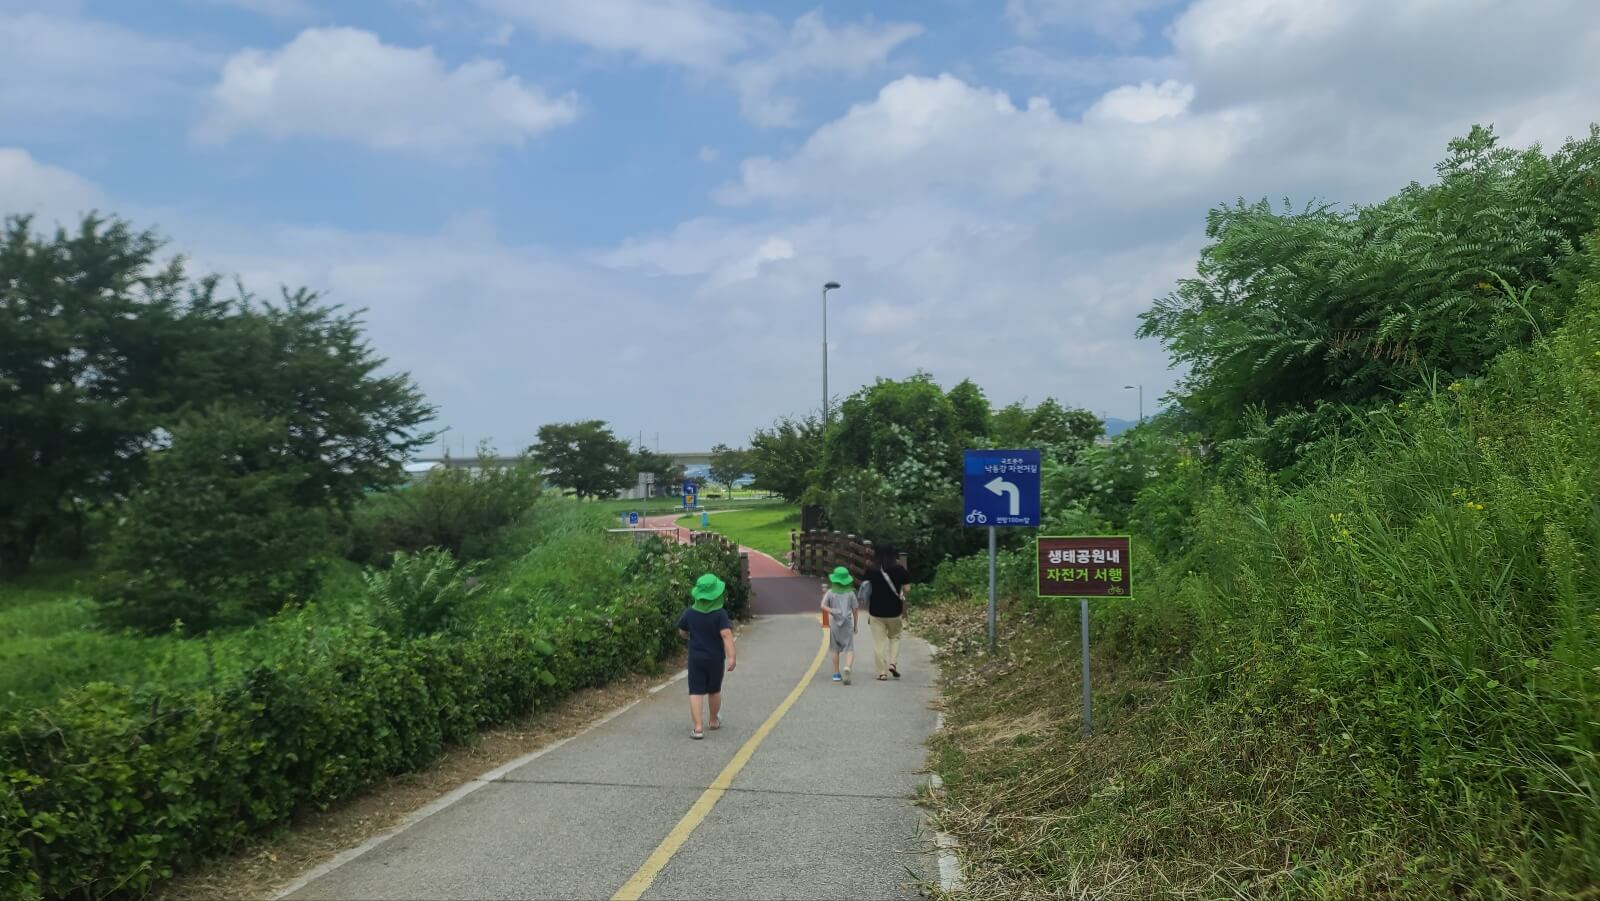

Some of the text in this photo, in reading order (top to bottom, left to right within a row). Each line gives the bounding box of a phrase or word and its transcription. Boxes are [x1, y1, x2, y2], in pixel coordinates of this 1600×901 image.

[984, 464, 1038, 473] 낙동강 자전거길
[1048, 549, 1120, 564] 생태공원내
[1047, 568, 1123, 582] 자전거 서행
